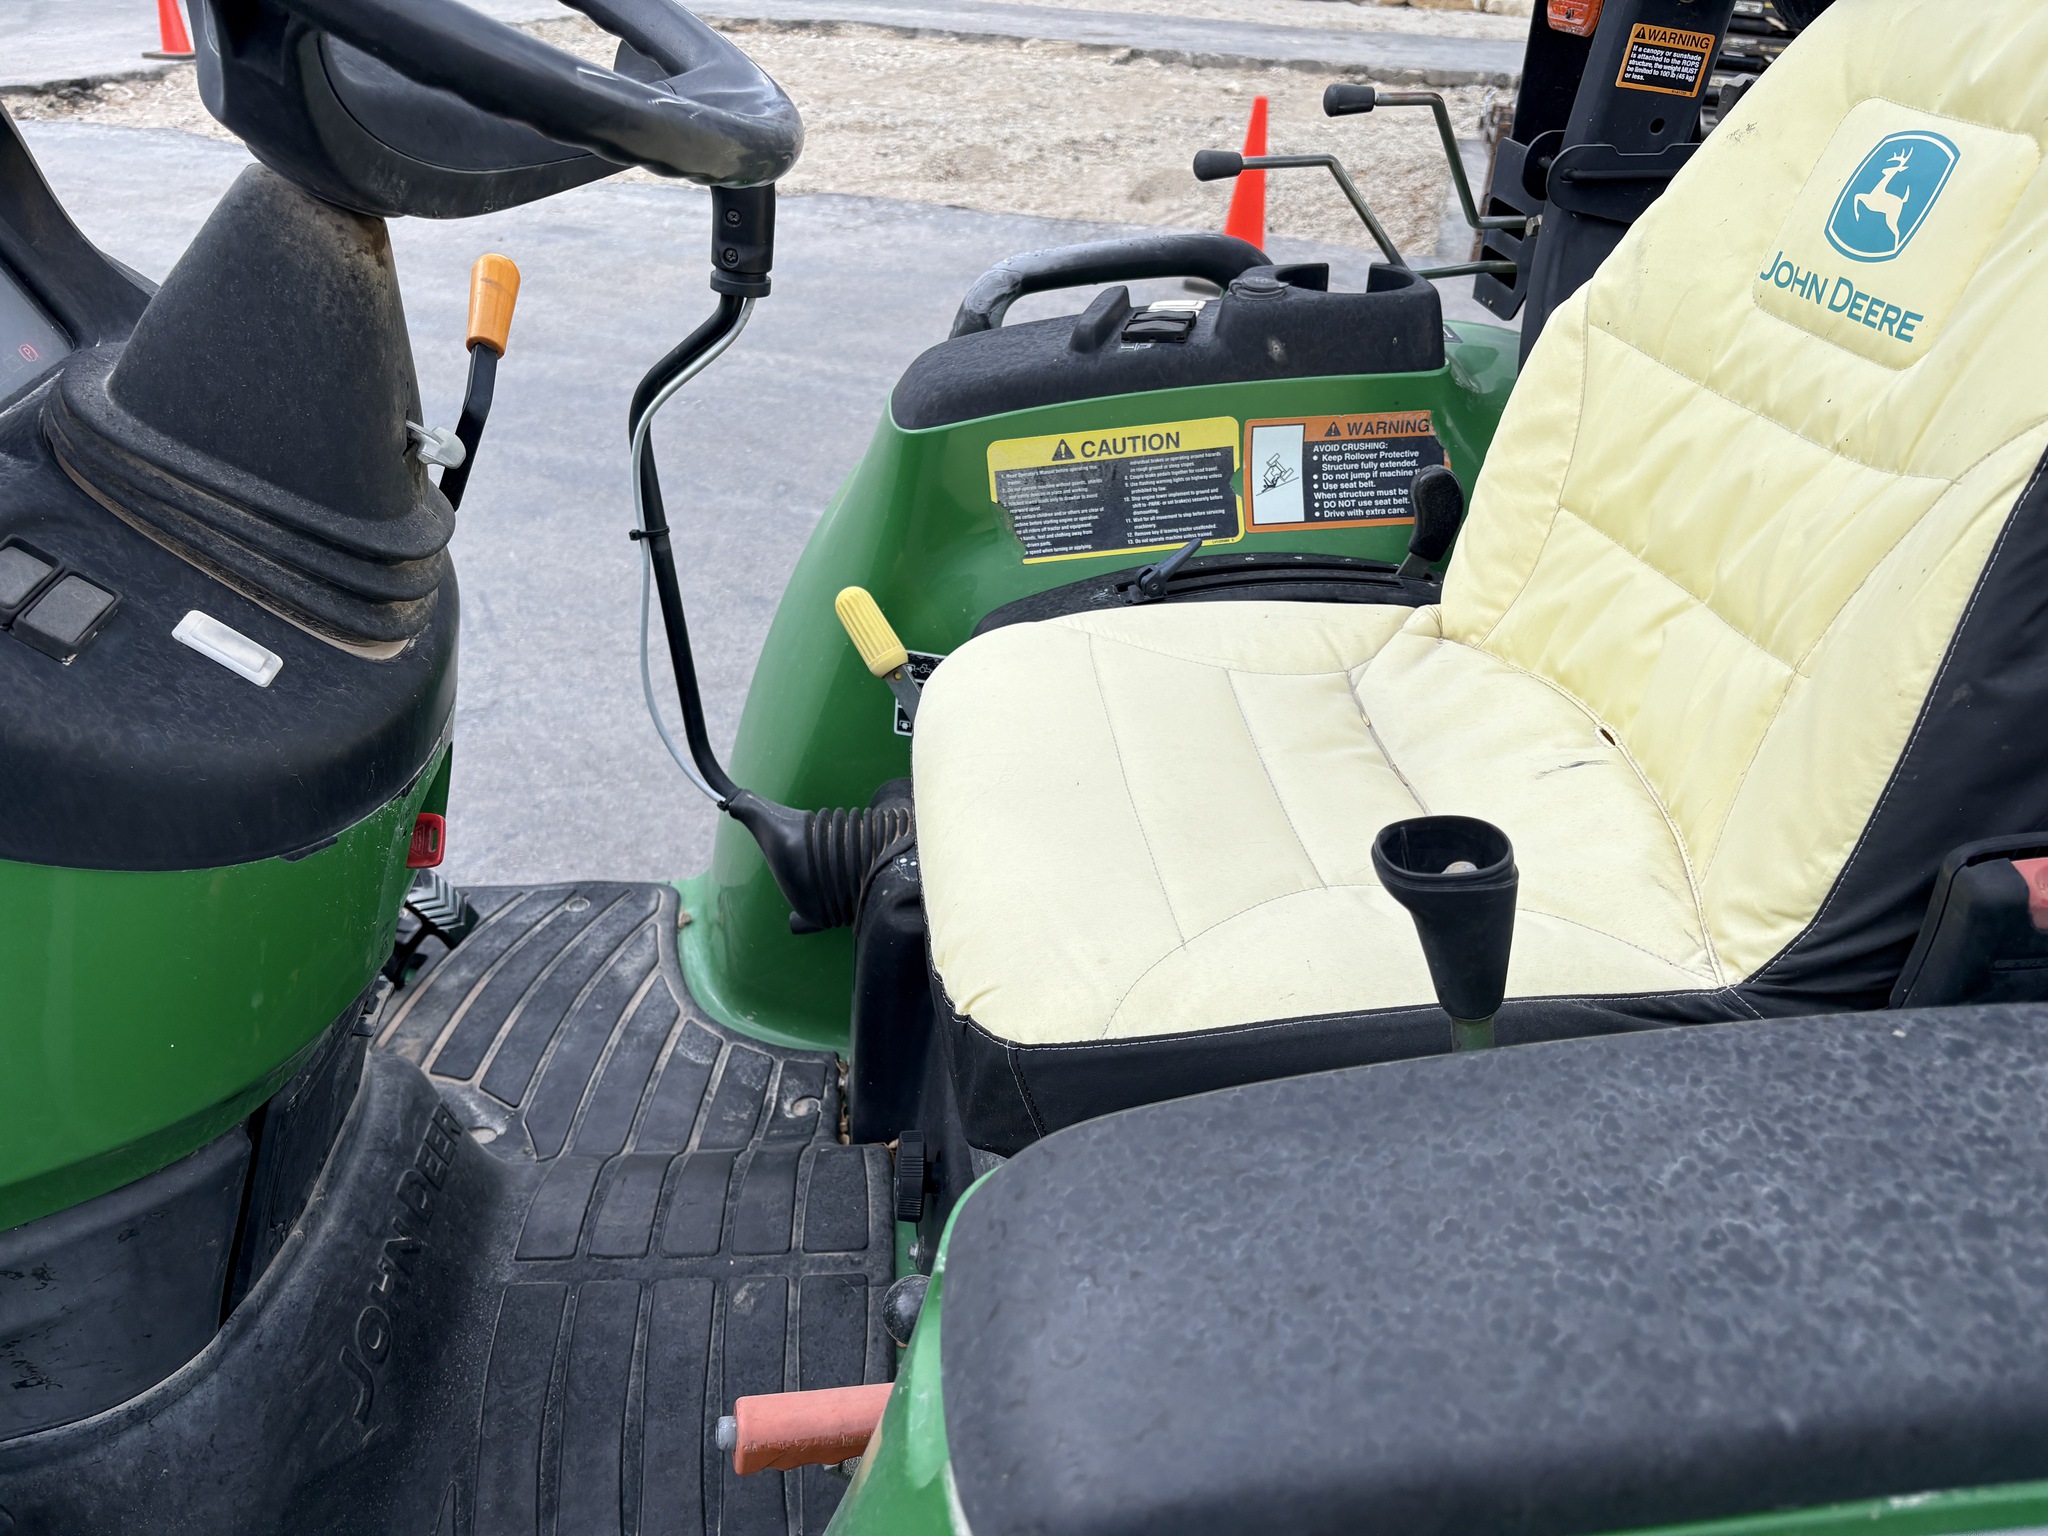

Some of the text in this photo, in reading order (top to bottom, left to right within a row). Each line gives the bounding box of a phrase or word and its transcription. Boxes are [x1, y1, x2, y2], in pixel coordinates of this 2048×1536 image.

[1648, 28, 1710, 49] WARNING
[1637, 54, 1663, 62] attached
[1682, 60, 1699, 68] ROPS
[1643, 48, 1664, 56] canopy
[1673, 53, 1701, 61] sunshade
[1629, 60, 1653, 68] structure,
[1663, 65, 1681, 73] weight
[1685, 74, 1695, 82] kg)
[1759, 251, 1924, 343] JOHN DEERE
[1347, 418, 1431, 436] WARNING
[1081, 431, 1181, 458] CAUTION
[1313, 442, 1387, 452] AVOID CRUSHING:
[1322, 454, 1342, 462] Keep
[1322, 460, 1418, 471] Structure fully extended.
[1351, 472, 1370, 480] jump
[339, 1216, 422, 1426] JOHN
